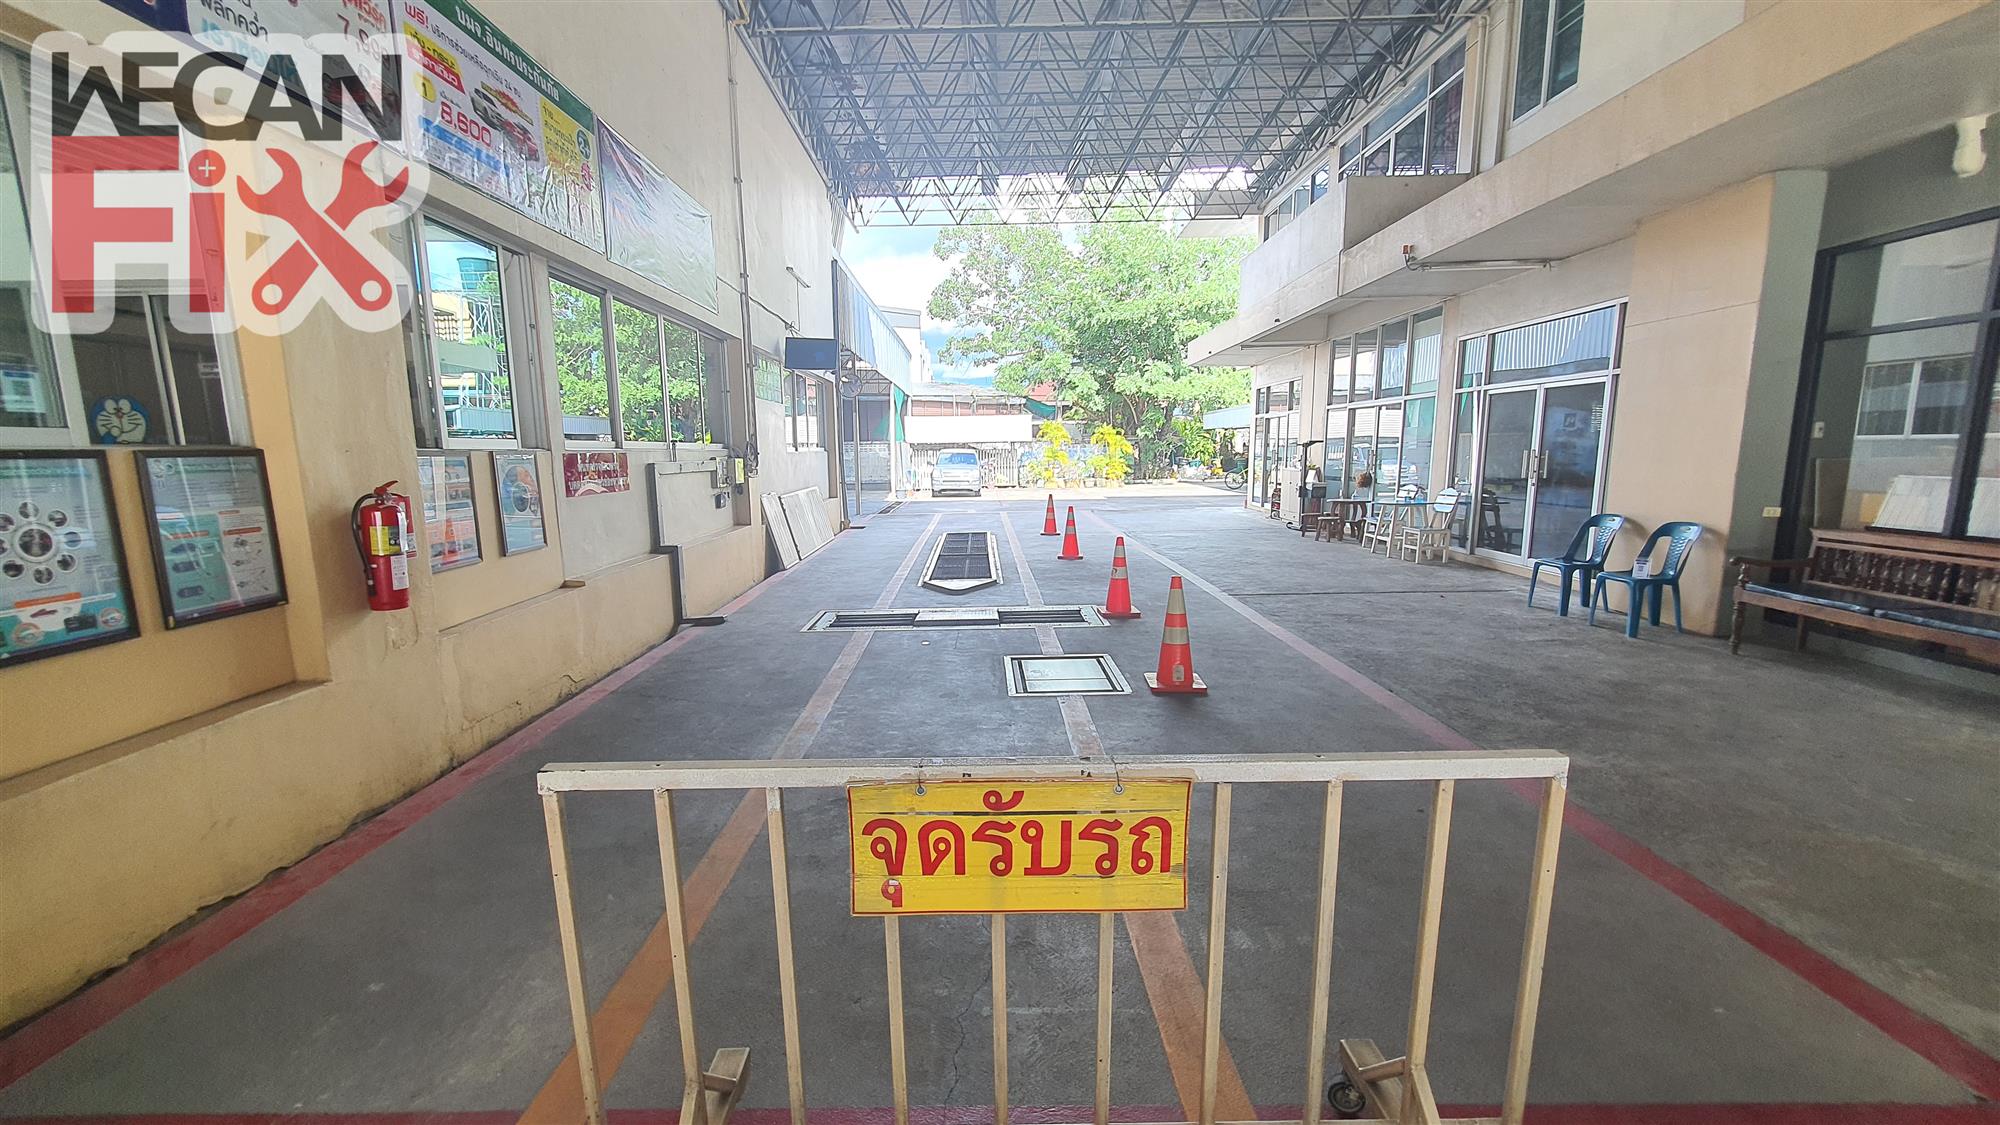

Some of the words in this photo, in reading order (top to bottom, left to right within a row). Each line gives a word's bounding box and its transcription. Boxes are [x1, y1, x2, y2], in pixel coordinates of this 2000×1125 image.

[404, 1, 429, 29] ฟรี!
[440, 101, 492, 147] 8,600
[862, 790, 1172, 908] จุดรับรถ
